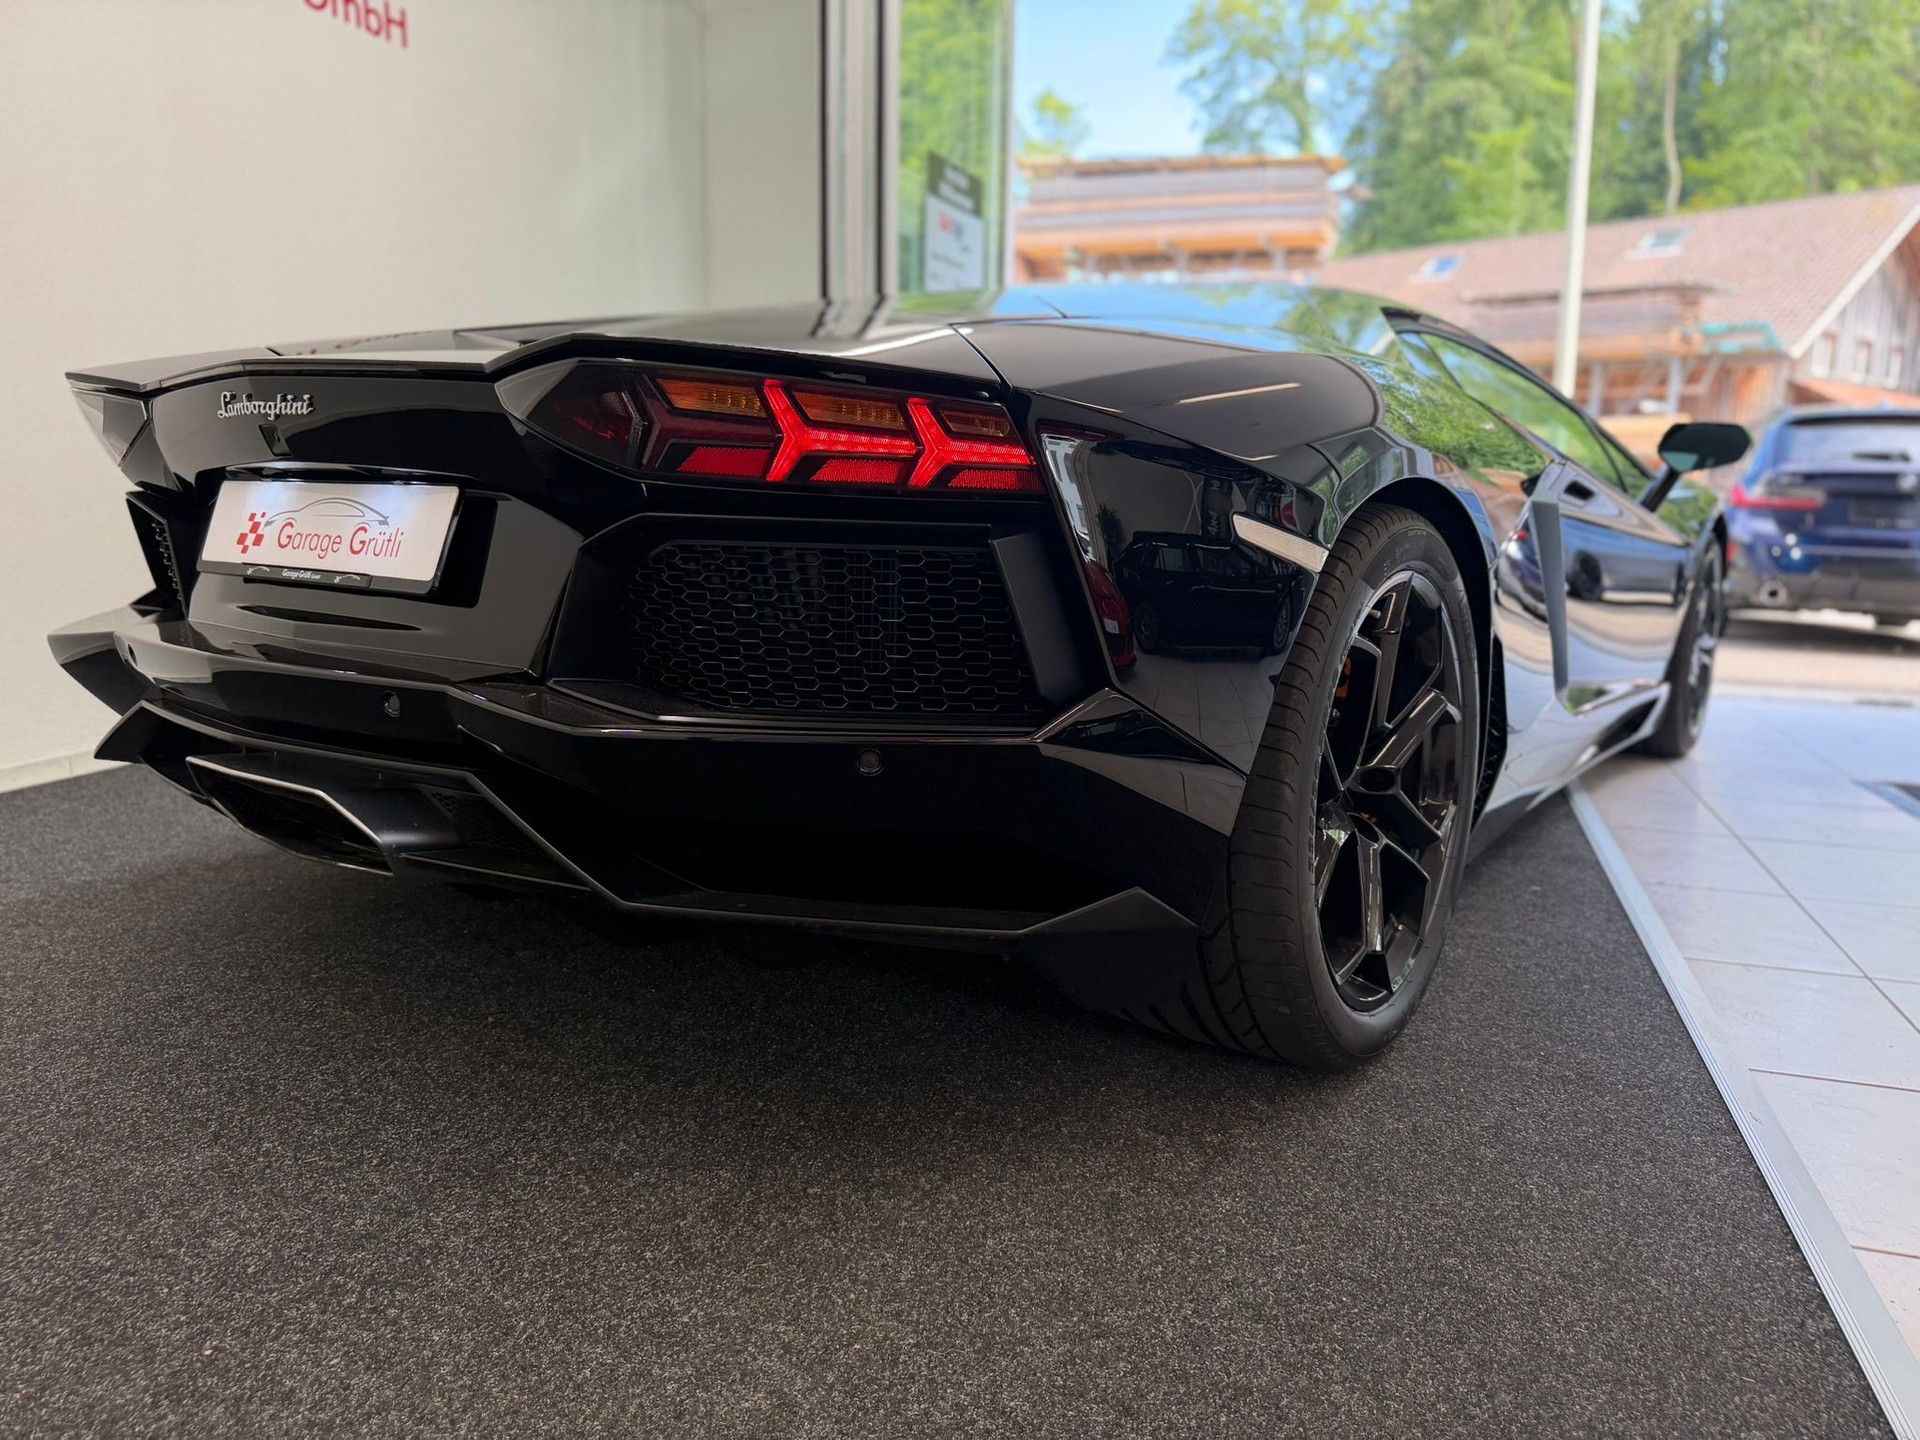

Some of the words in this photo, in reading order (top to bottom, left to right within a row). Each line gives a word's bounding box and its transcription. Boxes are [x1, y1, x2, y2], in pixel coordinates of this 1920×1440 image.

[217, 391, 314, 421] Lamborghini
[277, 521, 343, 560] Garage
[349, 525, 404, 558] Grütli
